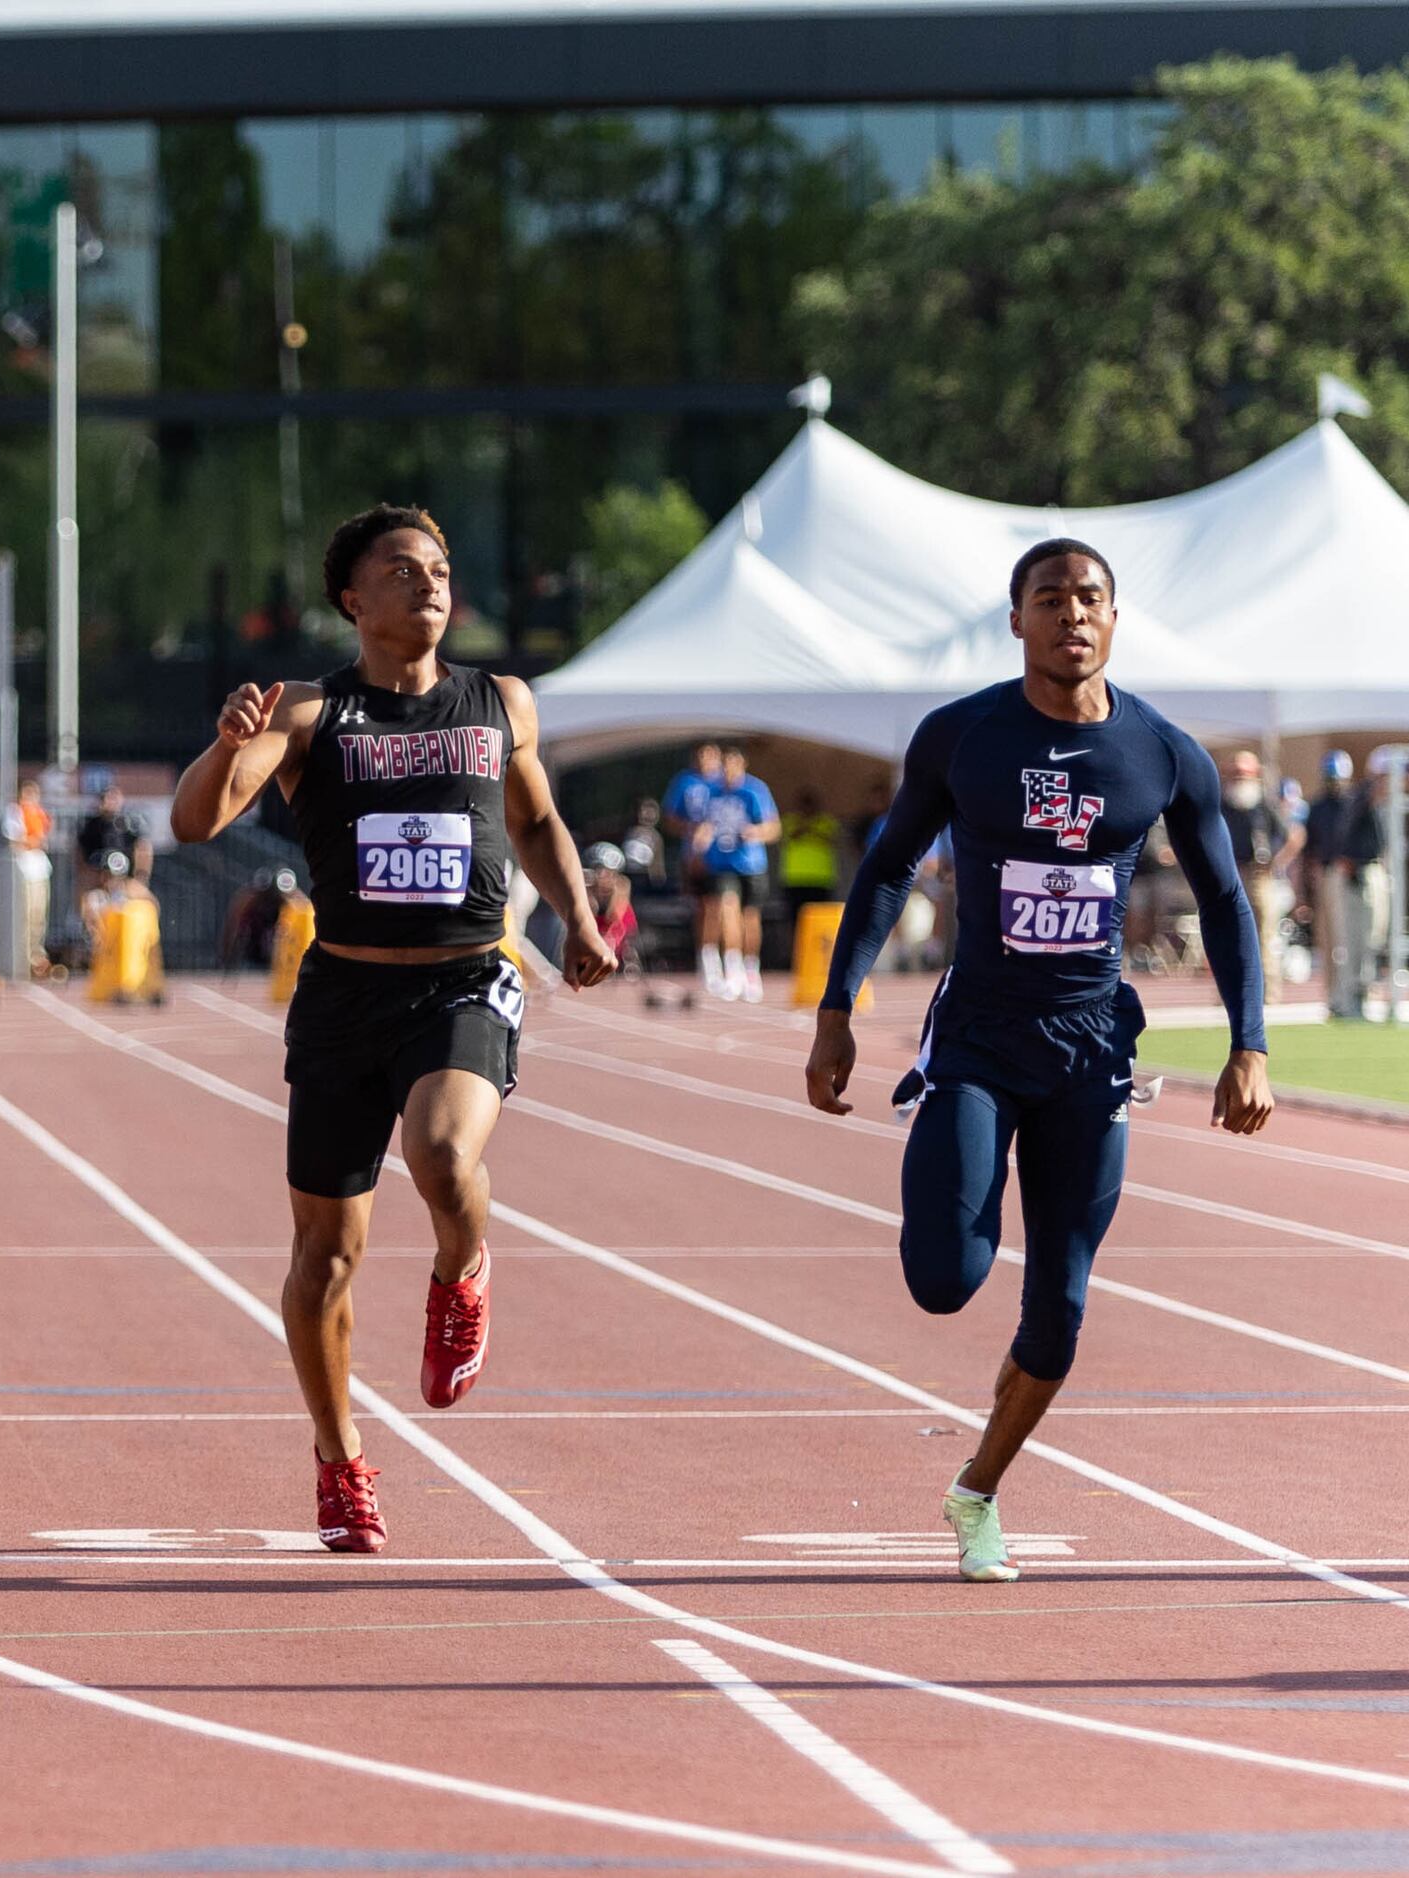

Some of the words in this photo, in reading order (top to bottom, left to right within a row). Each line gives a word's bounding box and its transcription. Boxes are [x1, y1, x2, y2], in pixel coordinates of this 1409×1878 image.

[338, 726, 503, 783] TIMBERVIEW
[1021, 768, 1105, 851] EV
[397, 826, 432, 837] STATE
[366, 848, 463, 889] 2965
[1042, 877, 1077, 890] STATE
[1011, 897, 1100, 939] 2674
